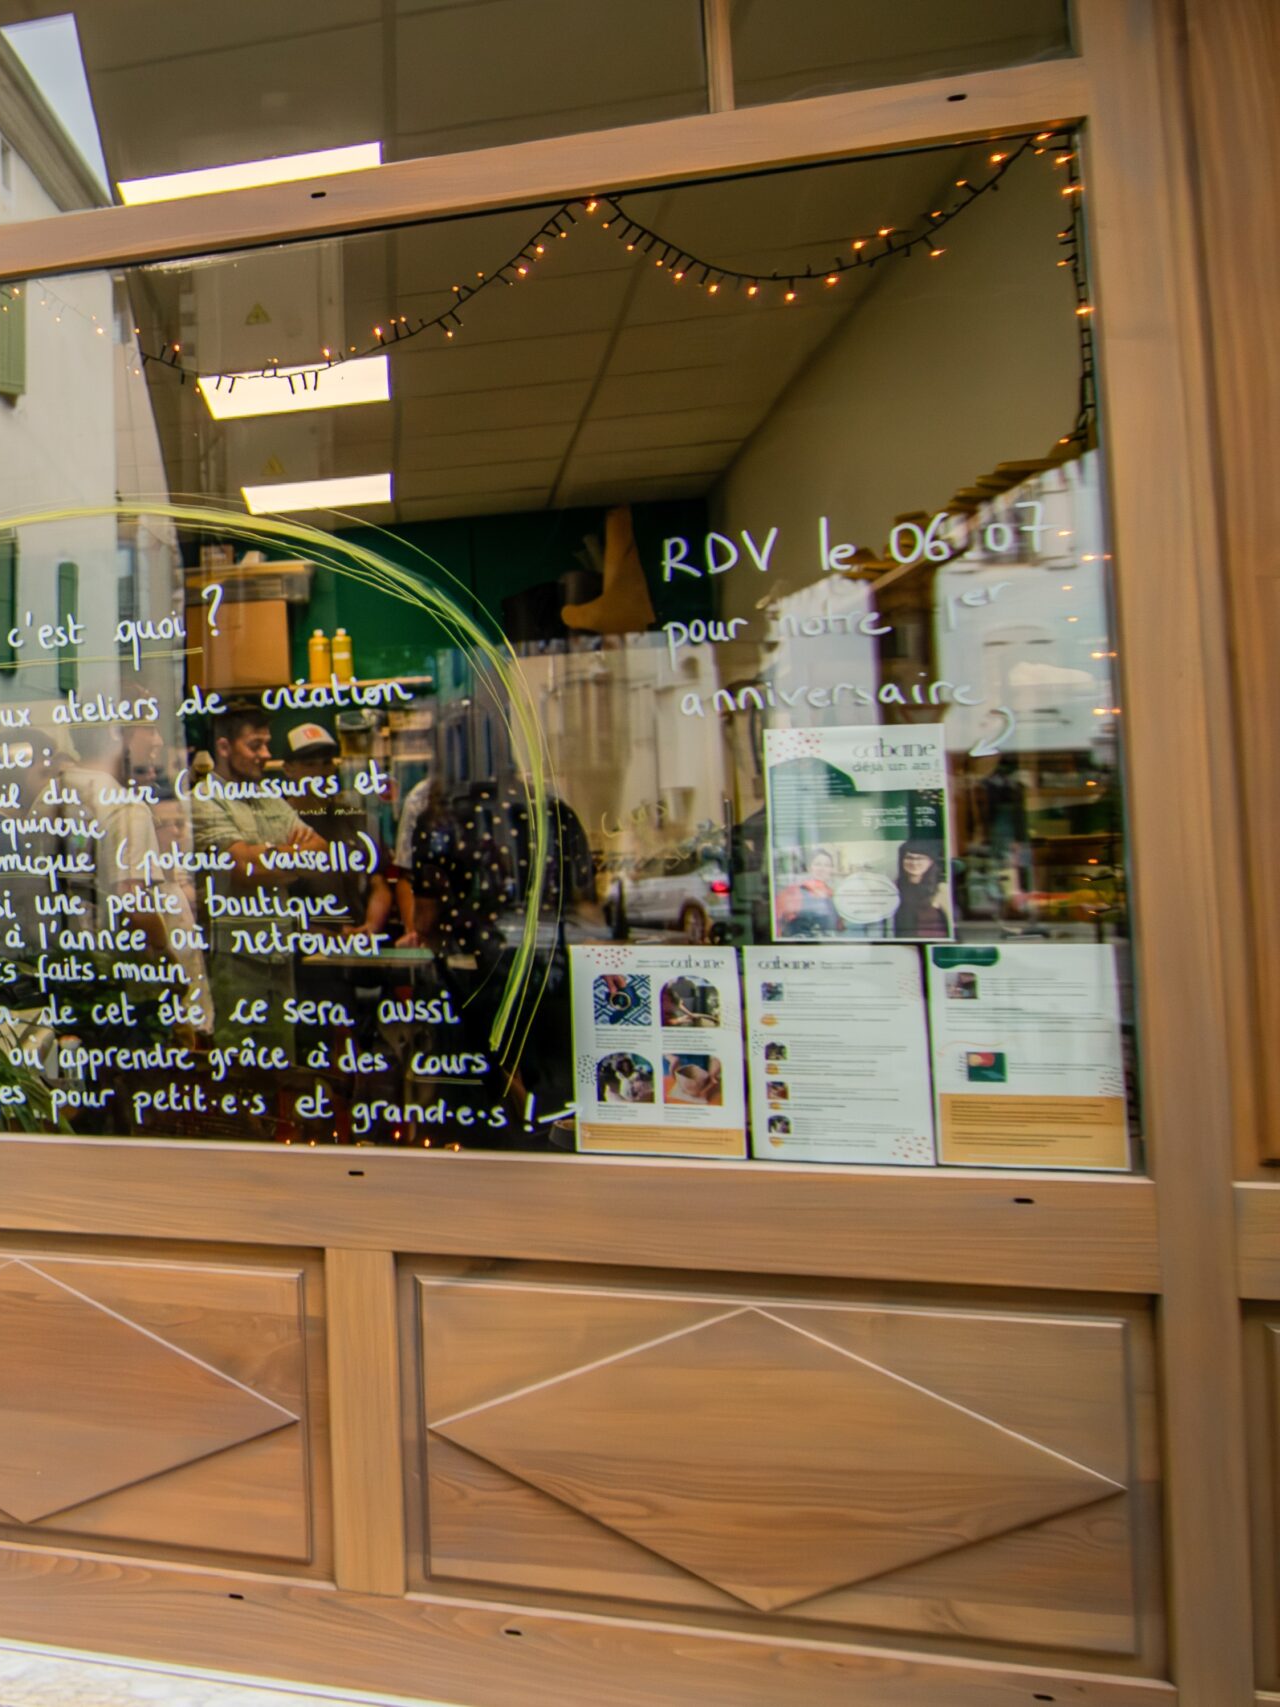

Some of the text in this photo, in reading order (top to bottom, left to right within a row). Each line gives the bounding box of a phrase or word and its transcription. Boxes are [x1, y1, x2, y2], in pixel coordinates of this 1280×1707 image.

[662, 527, 778, 582] RDV
[819, 516, 857, 571] le
[7, 610, 86, 649] c'est
[114, 611, 186, 671] quoi
[662, 618, 749, 672] pour
[775, 608, 892, 637] notre
[53, 690, 159, 724] ateliers
[176, 685, 227, 716] de
[262, 673, 413, 710] création
[680, 672, 984, 717] anniversaire
[852, 737, 937, 758] cabane
[43, 778, 81, 805] du
[98, 779, 159, 806] cuir
[355, 760, 389, 795] et
[35, 893, 86, 914] une
[106, 885, 181, 930] petite
[205, 876, 348, 929] boutique
[5, 923, 25, 948] à
[39, 918, 146, 951] l'année
[171, 924, 209, 950] où
[231, 923, 390, 956] retrouver
[37, 994, 77, 1026] de
[92, 992, 137, 1026] cet
[158, 988, 206, 1025] été
[229, 998, 268, 1023] ce
[284, 1001, 355, 1026] sera
[379, 989, 461, 1024] aussi
[12, 1034, 44, 1070] où
[59, 1042, 195, 1081] apprendre
[208, 1038, 289, 1081] grâce
[307, 1042, 330, 1068] à
[338, 1038, 389, 1075] des
[411, 1050, 490, 1075] cours
[49, 1088, 116, 1124] pour
[295, 1084, 334, 1119] et
